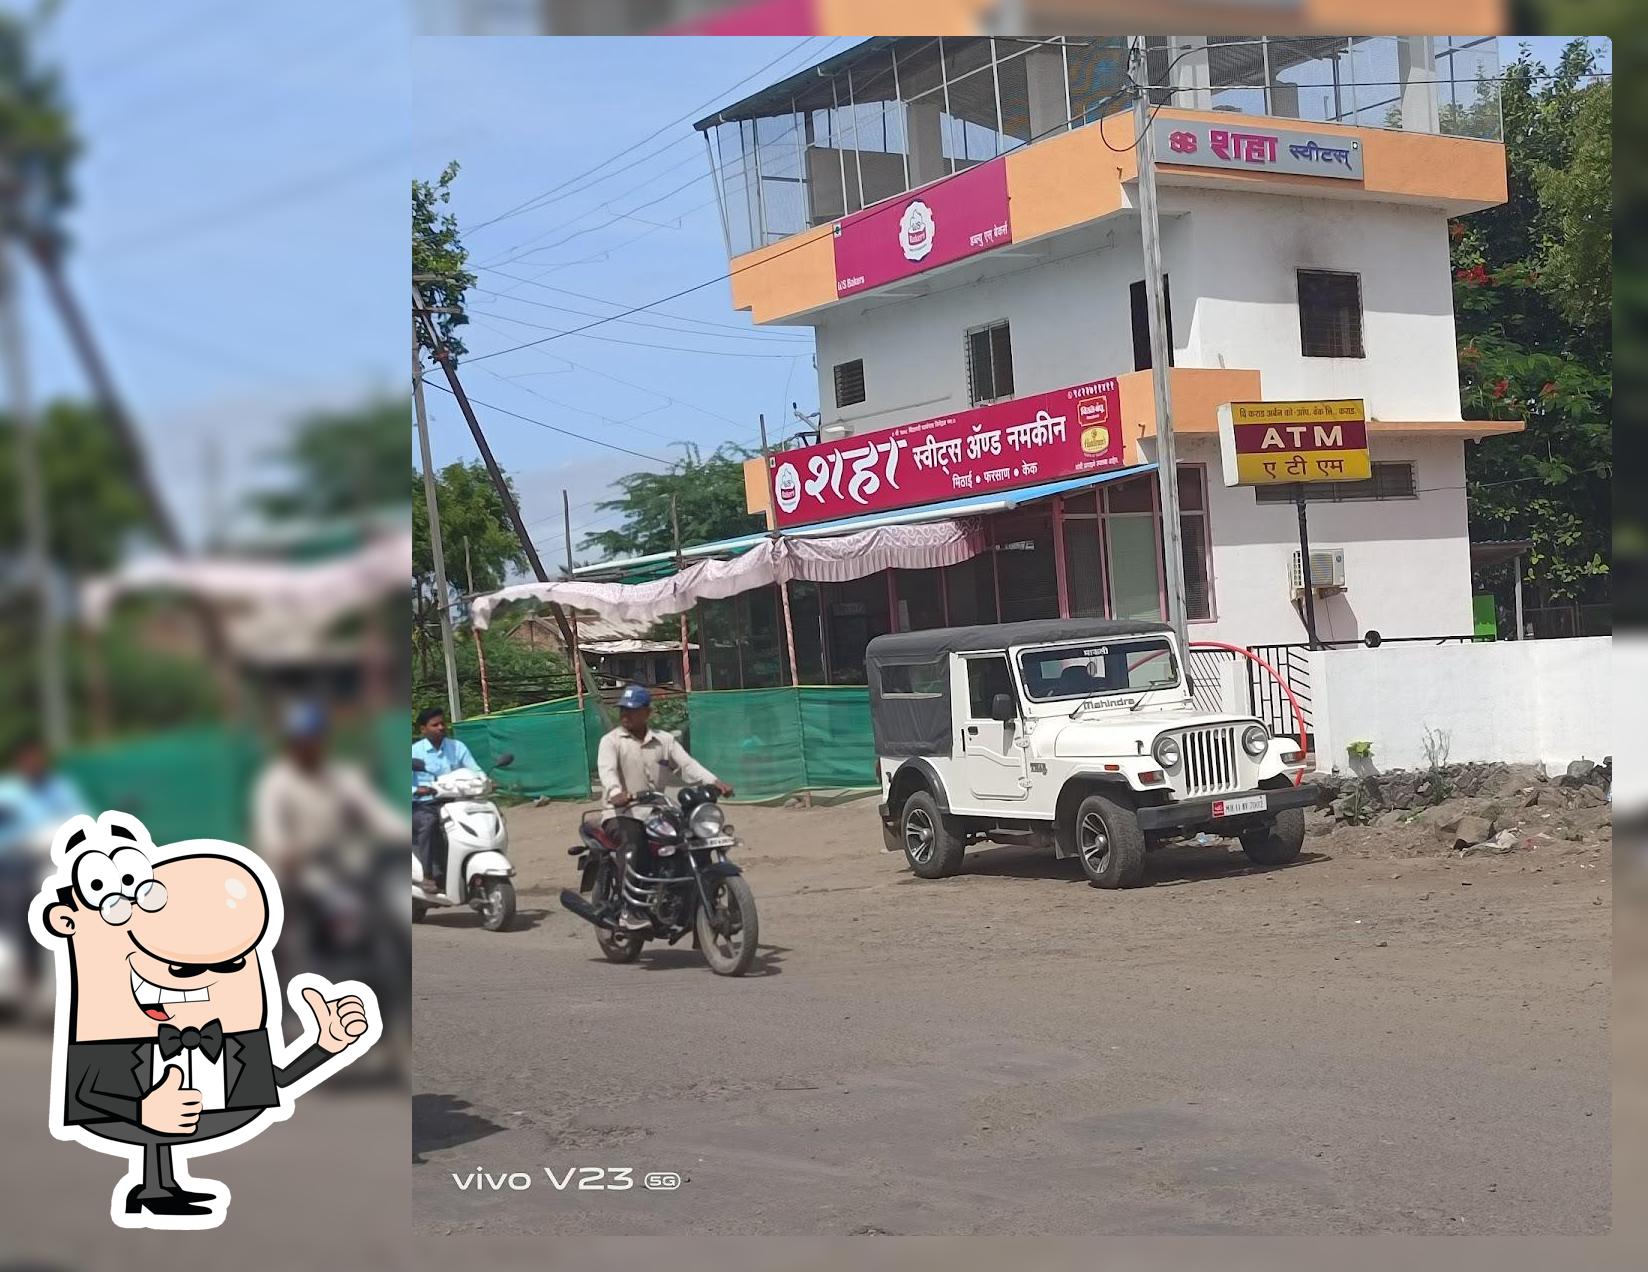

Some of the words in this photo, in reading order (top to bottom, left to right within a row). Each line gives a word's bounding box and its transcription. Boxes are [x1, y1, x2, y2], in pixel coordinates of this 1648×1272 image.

[1208, 129, 1279, 164] शहा
[1260, 425, 1344, 449] ATM
[804, 435, 908, 504] शहा
[1006, 410, 1067, 452] नमकीन
[1262, 461, 1277, 479] ए
[1285, 455, 1308, 476] टी
[1316, 459, 1344, 477] एम
[952, 470, 973, 489] मिठाई
[1021, 460, 1038, 476] केक
